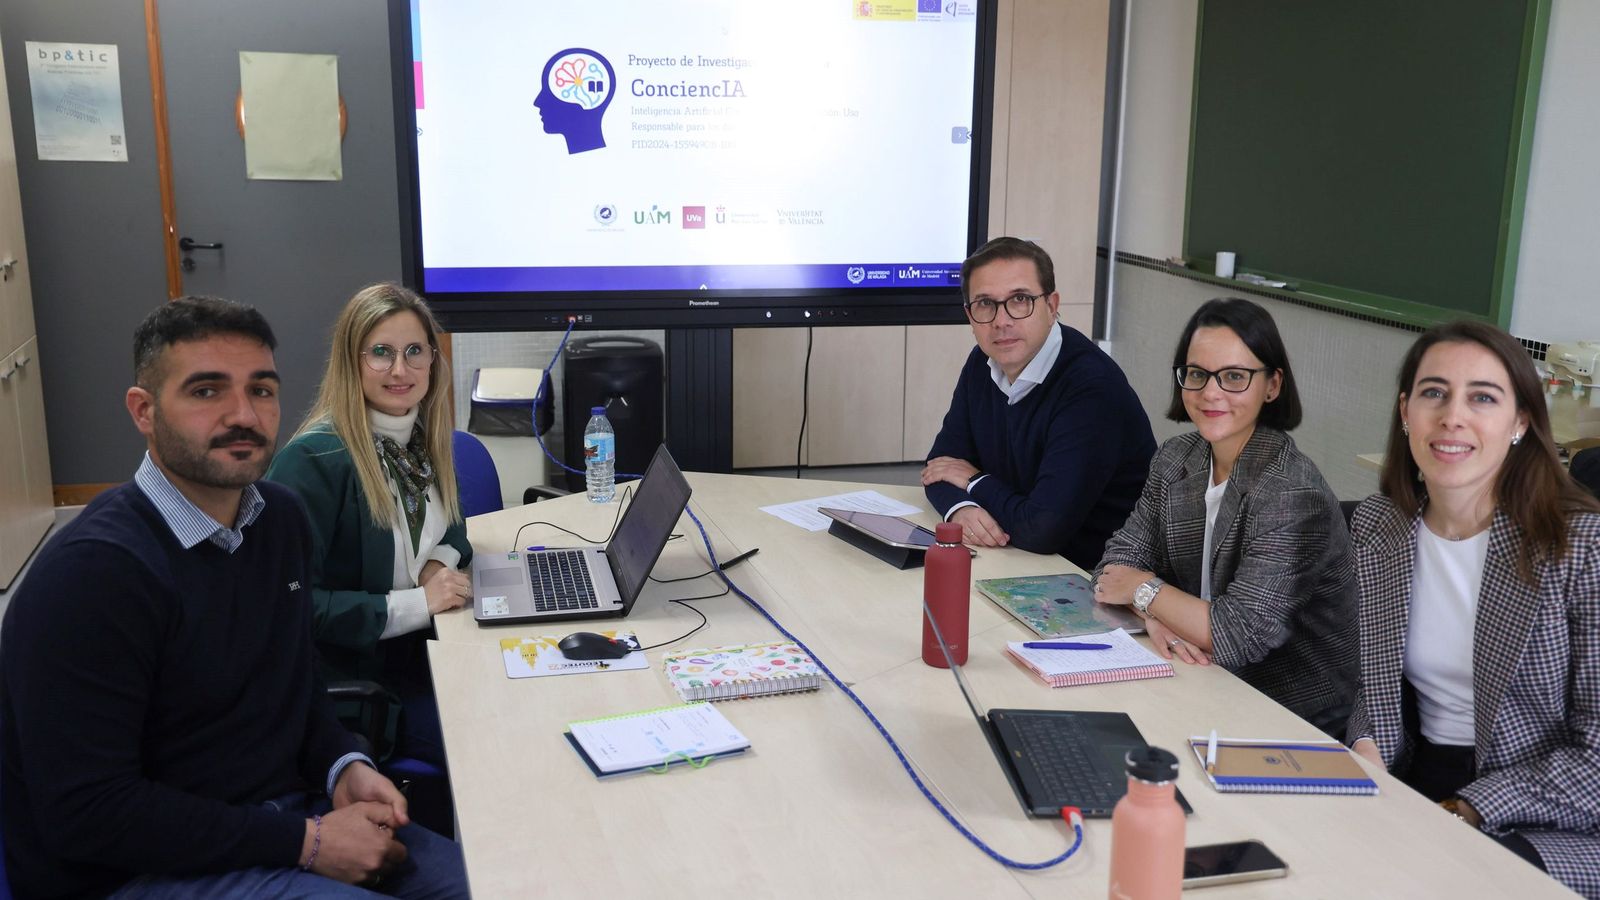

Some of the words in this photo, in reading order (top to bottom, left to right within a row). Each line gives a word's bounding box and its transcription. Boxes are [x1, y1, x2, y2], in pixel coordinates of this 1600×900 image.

[628, 54, 676, 68] Proyecto
[680, 55, 694, 67] de
[631, 79, 747, 98] ConciencIA
[631, 106, 681, 118] Inteligencia
[631, 121, 684, 132] Responsable
[686, 123, 705, 132] para
